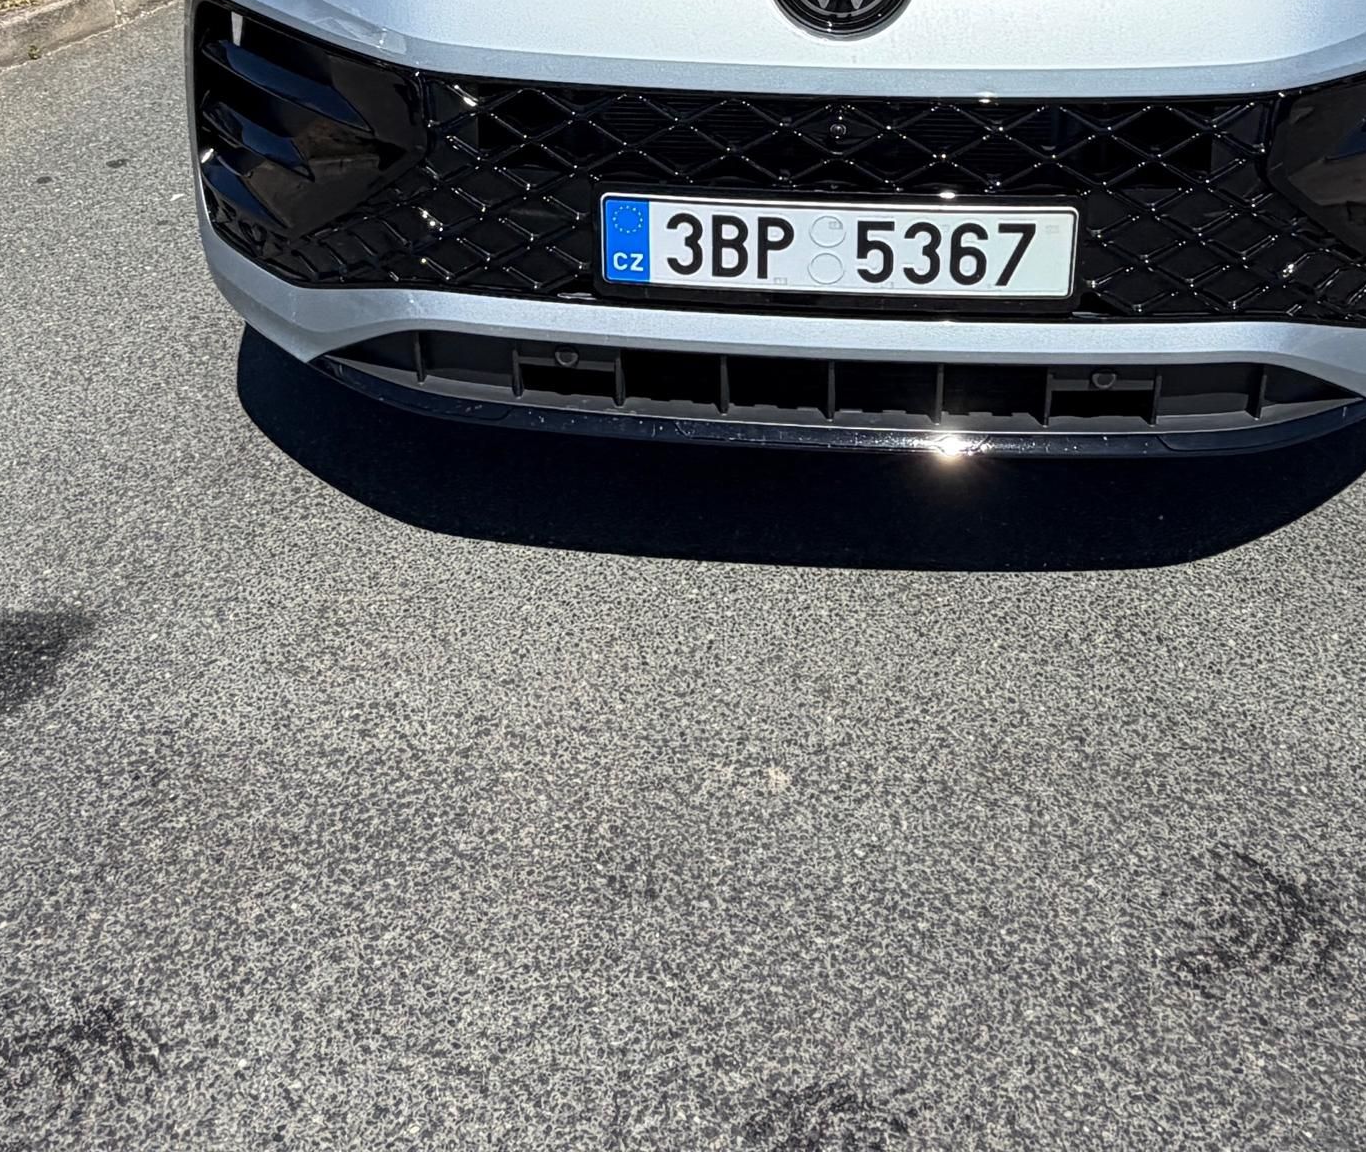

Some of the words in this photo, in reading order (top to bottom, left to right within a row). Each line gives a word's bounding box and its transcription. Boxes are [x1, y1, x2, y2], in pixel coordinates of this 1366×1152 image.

[613, 252, 644, 272] CZ
[665, 212, 795, 279] 3BP
[856, 220, 1038, 286] 5367
